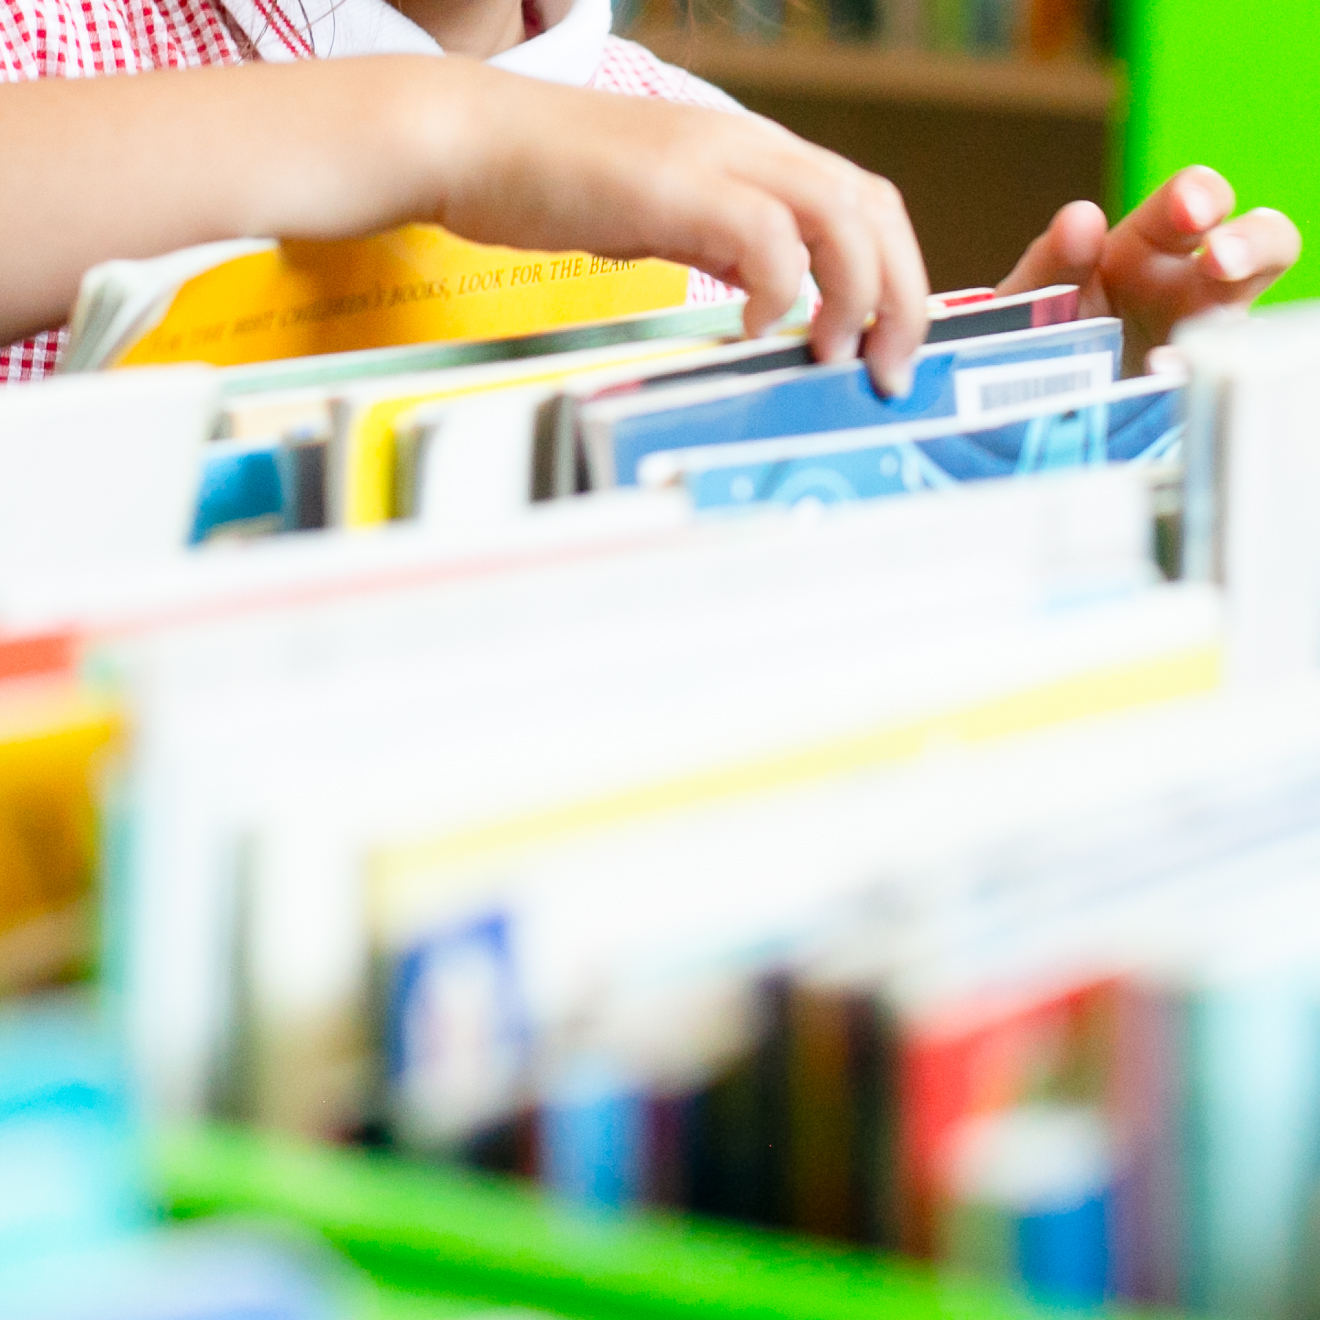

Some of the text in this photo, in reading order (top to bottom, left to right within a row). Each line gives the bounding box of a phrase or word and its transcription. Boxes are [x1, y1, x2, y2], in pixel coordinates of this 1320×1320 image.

[458, 269, 505, 295] LOOK
[510, 263, 543, 287] FOR
[550, 257, 584, 281] THE
